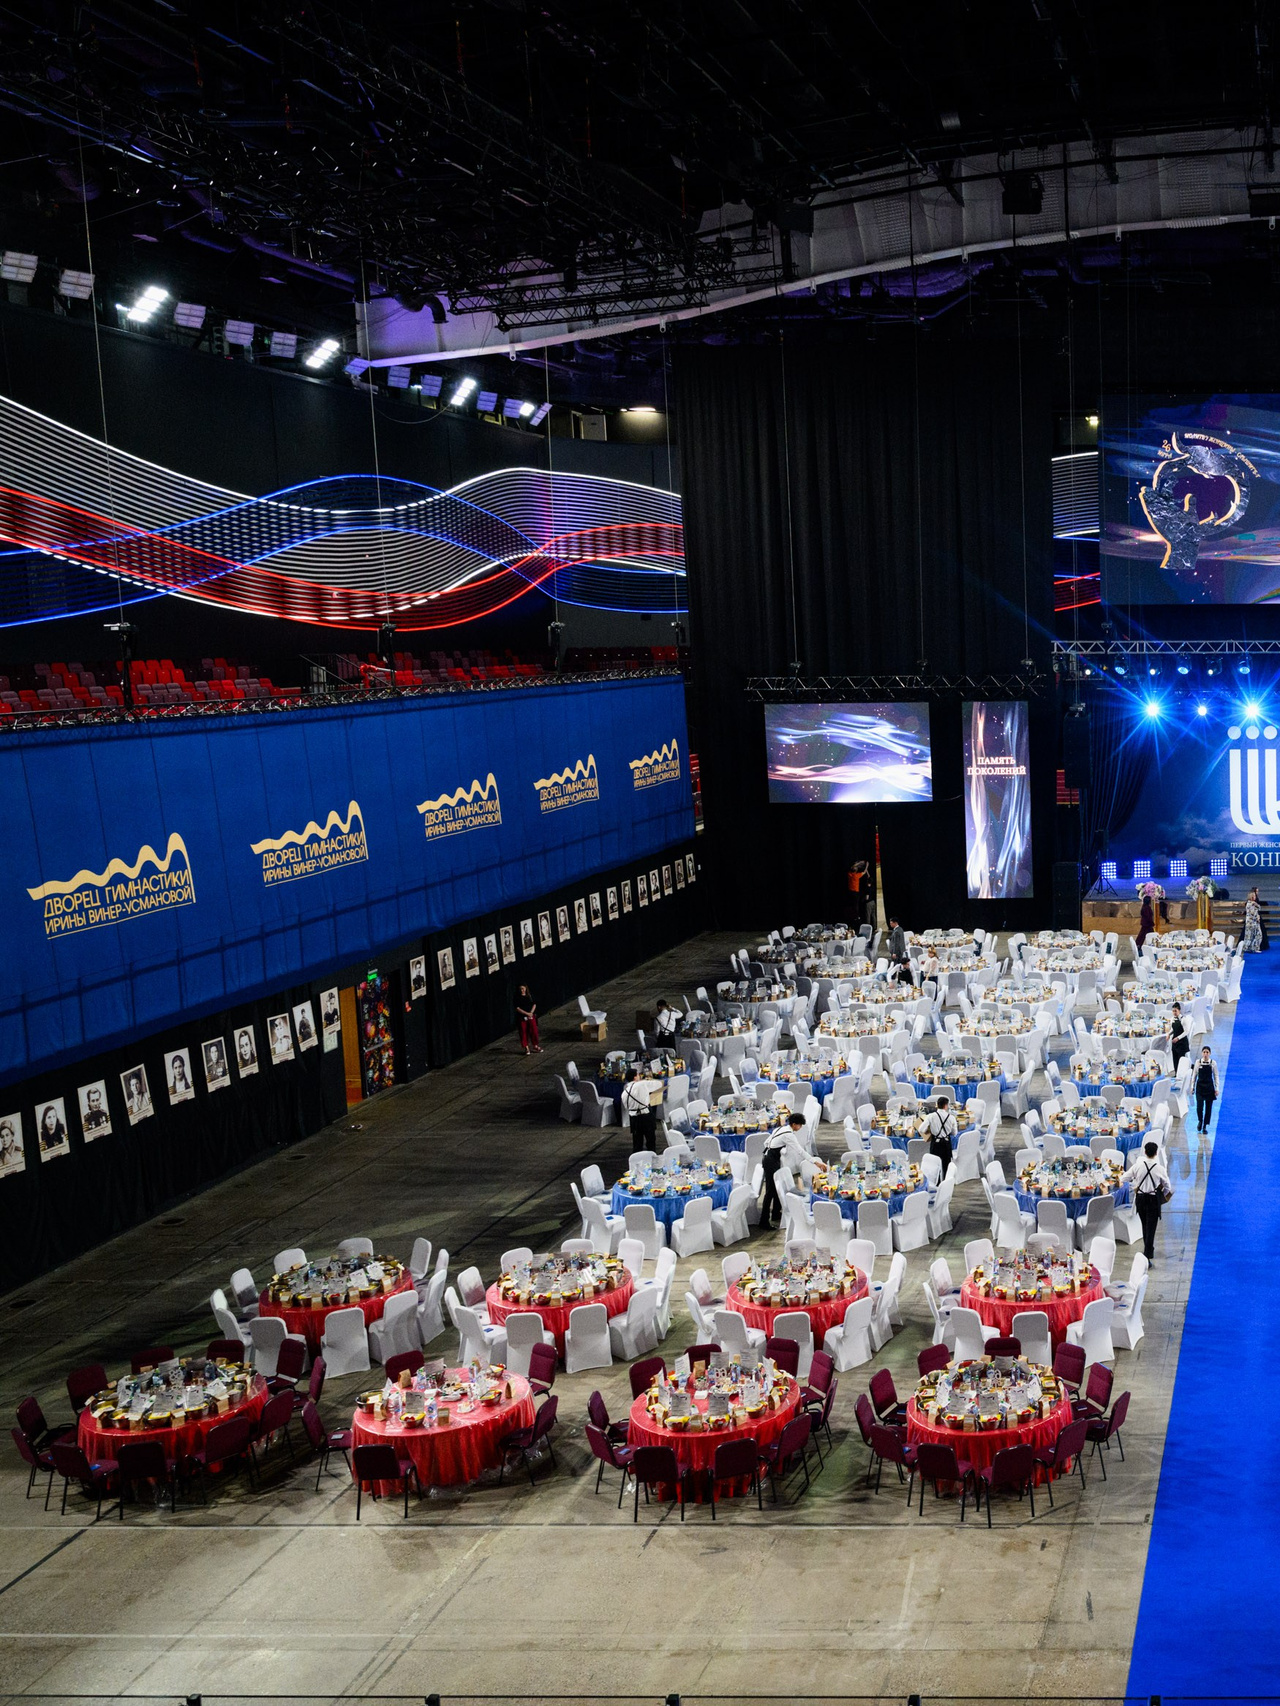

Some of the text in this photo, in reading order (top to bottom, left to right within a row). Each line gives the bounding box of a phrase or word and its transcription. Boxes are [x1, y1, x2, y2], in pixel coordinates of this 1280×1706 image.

[1162, 440, 1172, 452] 26
[967, 765, 1026, 775] ПОКОЛЕНИЙ
[977, 756, 1016, 765] ПАМЯТЬ
[425, 800, 499, 826] ДВОРЕЦ ГИМНАСТИКИ
[262, 831, 364, 869] ДВОРЕЦ ГИМНАСТИКИ
[262, 845, 366, 883] ИРИНЫ ВИНЕР-УСМАНОВОЙ
[44, 868, 190, 918] ДВОРЕЦ ГИМНАСТИКИ
[44, 886, 192, 934] ИРИНЫ ВИНЕР-УСМАНОВОЙ
